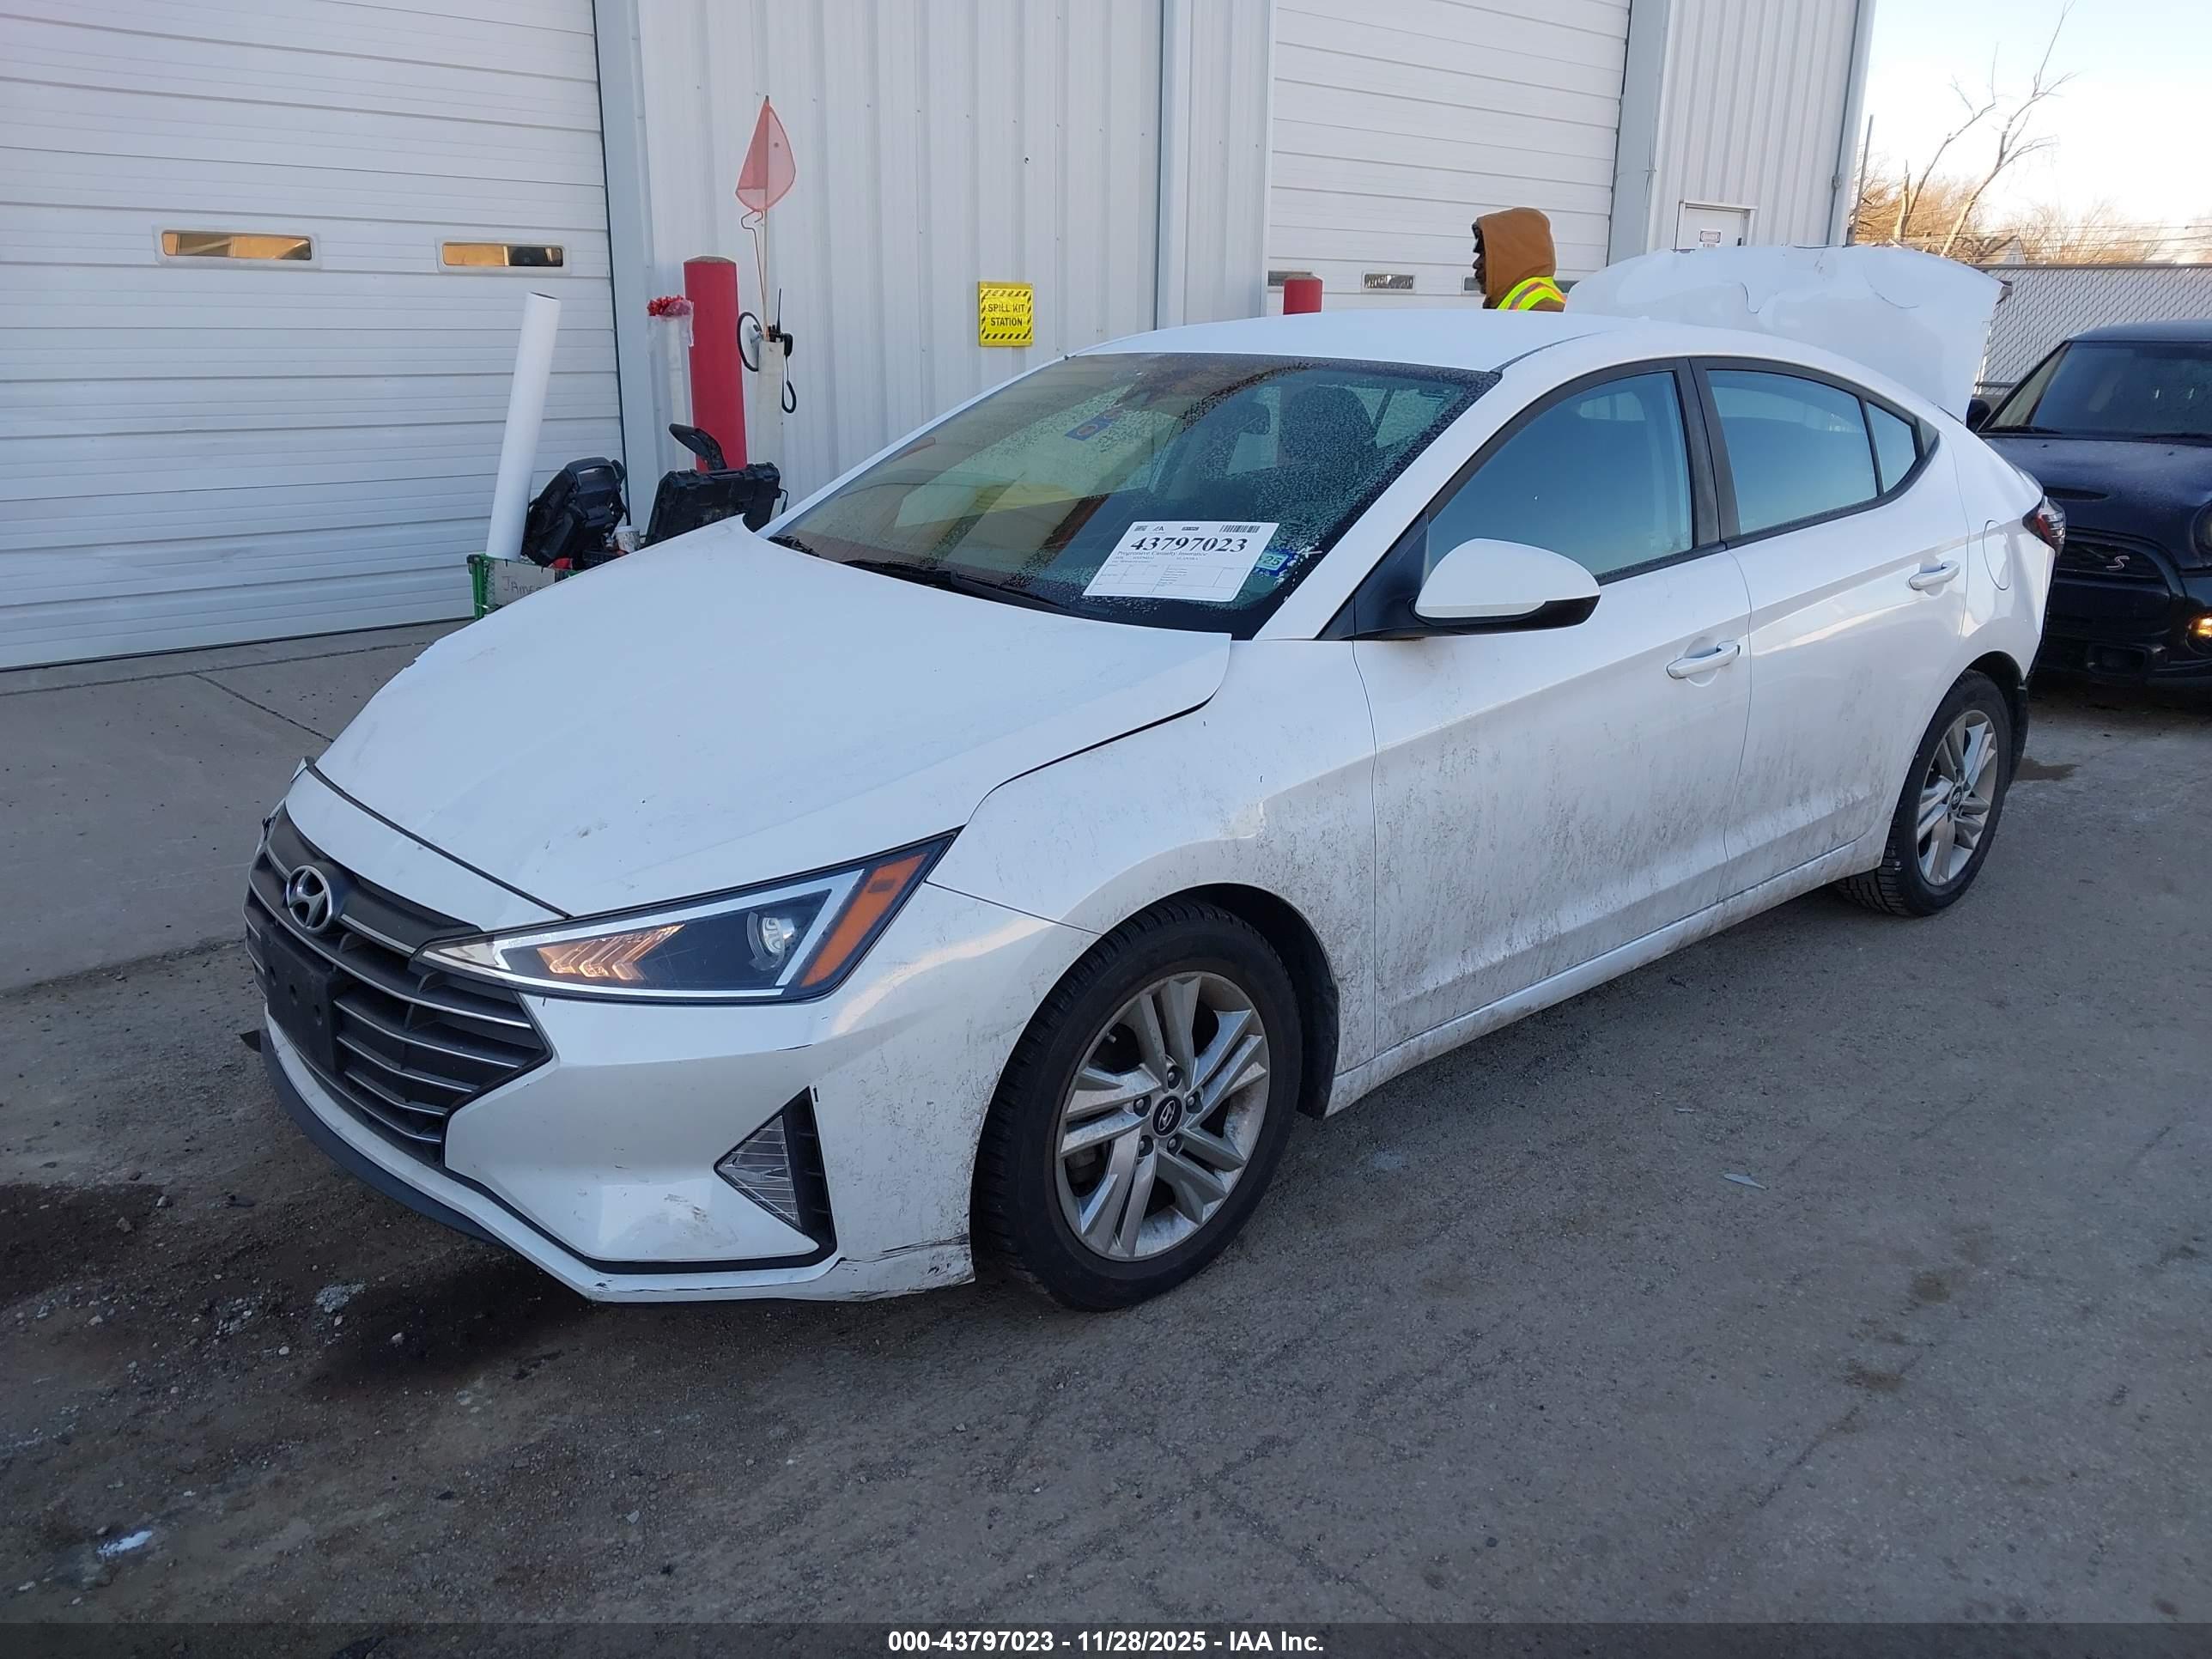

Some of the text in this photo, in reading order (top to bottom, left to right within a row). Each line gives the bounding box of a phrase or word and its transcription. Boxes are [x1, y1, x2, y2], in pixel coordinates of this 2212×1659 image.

[988, 303, 1025, 313] SPILL KIT
[991, 318, 1023, 326] STATION
[1130, 537, 1248, 552] 43797023
[1262, 556, 1282, 566] 25
